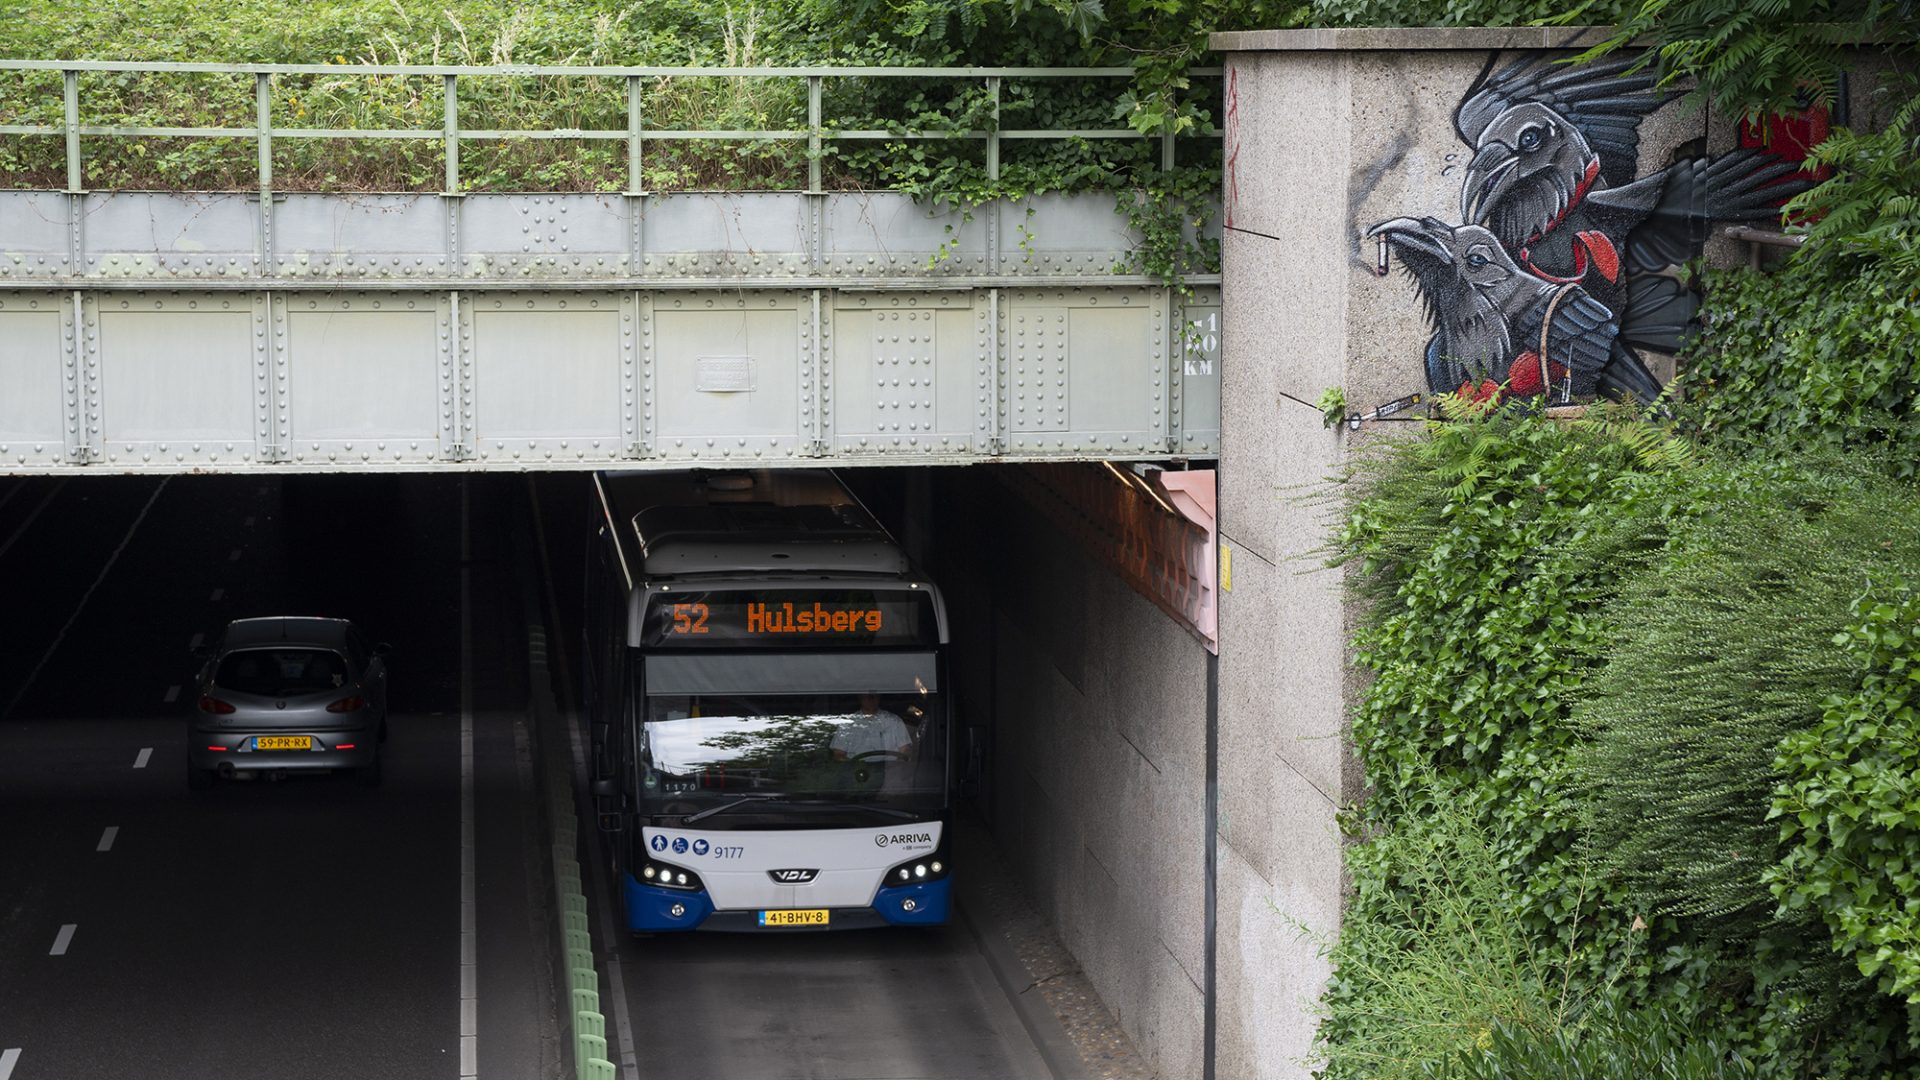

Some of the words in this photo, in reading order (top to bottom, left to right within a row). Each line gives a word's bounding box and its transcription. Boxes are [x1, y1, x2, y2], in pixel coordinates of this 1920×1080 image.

[1184, 360, 1213, 376] KM
[673, 603, 709, 634] 52
[747, 602, 882, 633] Hulsberg
[260, 738, 308, 747] 59-PR-RX
[665, 783, 696, 791] 1170
[890, 833, 932, 844] ARRIVA
[714, 846, 744, 859] 9177
[775, 870, 811, 881] VDL
[770, 912, 823, 923] 41-BHV-8
